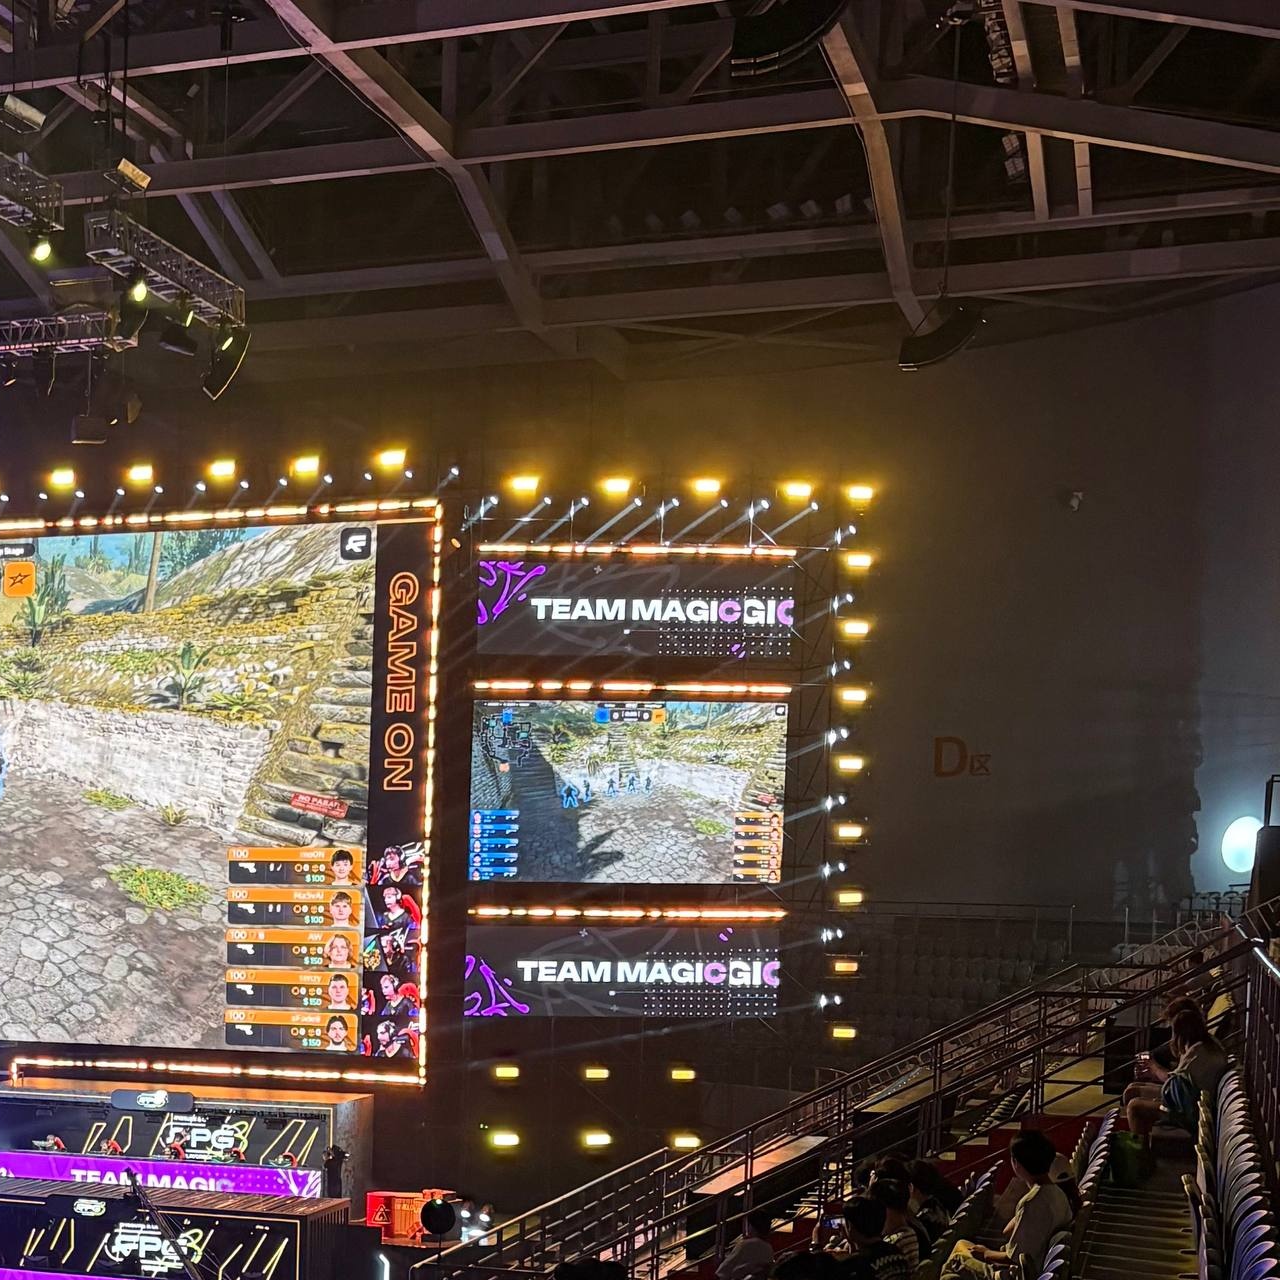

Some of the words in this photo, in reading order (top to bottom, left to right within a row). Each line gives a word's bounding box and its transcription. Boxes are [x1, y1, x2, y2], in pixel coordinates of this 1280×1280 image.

[530, 598, 626, 620] TEAM
[385, 571, 420, 713] GAME
[383, 722, 415, 791] ON
[232, 850, 249, 858] 100
[232, 890, 248, 899] 100
[231, 930, 247, 939] 100
[230, 971, 246, 979] 100
[516, 960, 612, 983] TEAM
[229, 1011, 245, 1020] 100
[147, 1173, 234, 1193] MAGIC
